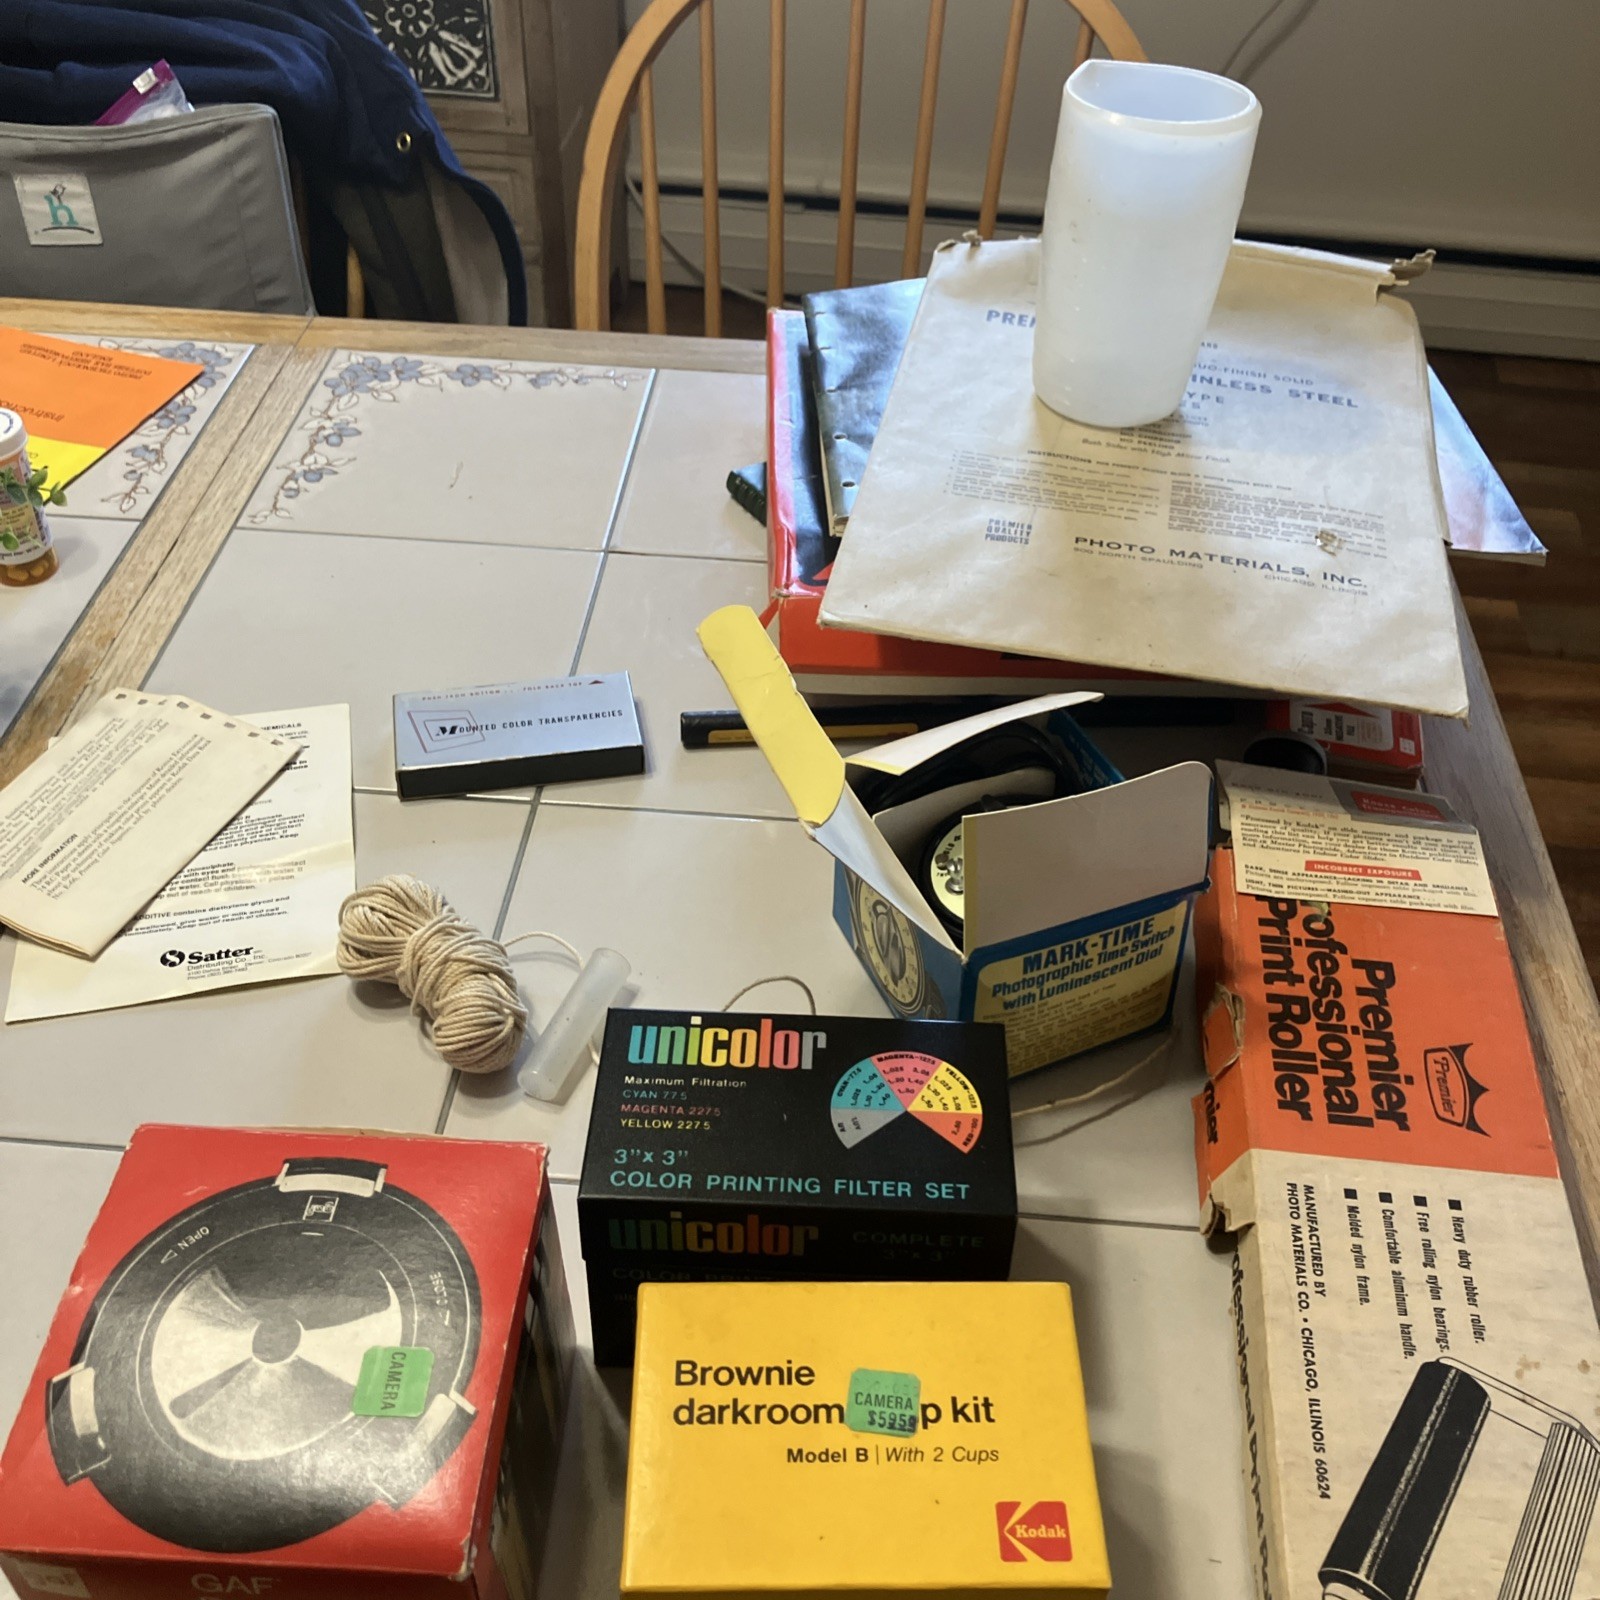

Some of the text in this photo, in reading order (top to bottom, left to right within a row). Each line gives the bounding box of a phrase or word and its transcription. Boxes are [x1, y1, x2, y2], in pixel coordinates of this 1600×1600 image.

[1187, 391, 1225, 404] YPE
[1192, 374, 1359, 409] INLESS STEEL
[985, 534, 1029, 545] PRODUCTS
[987, 526, 1031, 537] QUALITY
[989, 519, 1032, 530] PREMIER
[1075, 537, 1156, 554] PHOTO
[1323, 571, 1367, 588] INC.
[1099, 550, 1136, 560] NORTH
[435, 709, 623, 736] MOUNTED COLOR TRANSPARENCIES
[21, 833, 78, 884] MORE INFORMATION
[1314, 862, 1413, 878] INCORRECT EXPOSURE
[173, 908, 206, 916] contains
[187, 946, 254, 965] Satter
[992, 924, 1175, 998] Photographic Time Switch
[1022, 917, 1155, 975] MARK-TIME
[187, 959, 234, 972] Distributing
[1003, 944, 1164, 1011] with Luminescent Dial
[1256, 895, 1319, 1121] Print Roller
[1301, 899, 1374, 1128] ofessional
[627, 1015, 827, 1070] unicolor
[1351, 958, 1410, 1132] Premier
[623, 1089, 657, 1099] CYAN
[624, 1075, 747, 1088] Maximum Filtration
[1433, 1056, 1456, 1117] Premier
[621, 1104, 685, 1115] MAGENTA
[621, 1119, 673, 1129] YELLOW
[1203, 1080, 1219, 1145] mier
[610, 1170, 971, 1200] COLOR PRINTING FILTER SET
[177, 1226, 211, 1251] OPEN
[608, 1211, 820, 1257] unicolor
[851, 1231, 985, 1249] COMPLETE
[1304, 1184, 1327, 1297] MANUFACTURED BY
[1347, 1206, 1371, 1306] Molded nylon frame.
[428, 1270, 450, 1309] CLOSE
[1382, 1209, 1417, 1359] Comfortable aluminum handle.
[1416, 1212, 1452, 1353] Free rolling nylon bearings.
[1451, 1216, 1487, 1344] Heavy duty rubber roller.
[1286, 1182, 1331, 1500] PHOTO MATERIALS CO. CHICAGO, ILLINOIS 60624
[379, 1351, 407, 1412] CAMERA
[674, 1359, 816, 1387] Brownie
[673, 1398, 844, 1425] darkroom
[951, 1395, 996, 1424] kit
[855, 1392, 913, 1410] CAMERA
[787, 1446, 999, 1465] Model B With 2 Cups
[1015, 1524, 1067, 1539] Kodak
[191, 1573, 275, 1595] GAF
